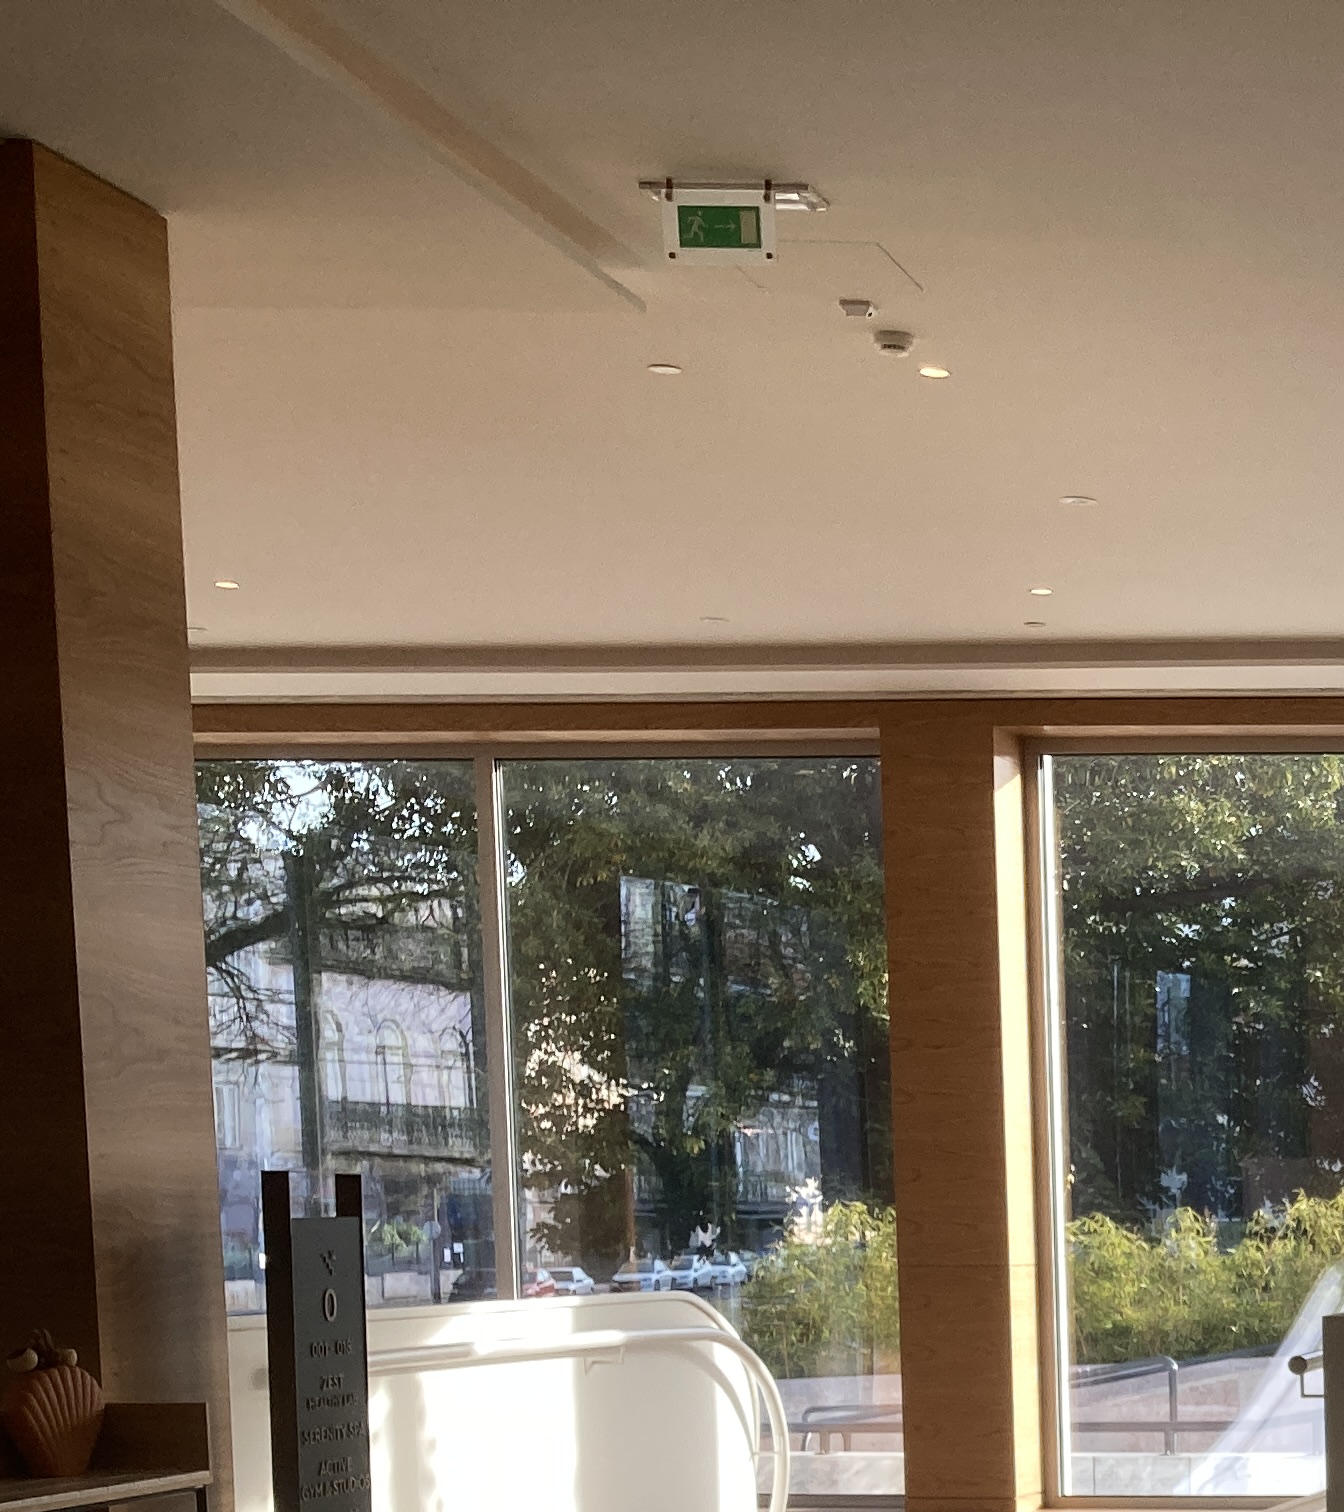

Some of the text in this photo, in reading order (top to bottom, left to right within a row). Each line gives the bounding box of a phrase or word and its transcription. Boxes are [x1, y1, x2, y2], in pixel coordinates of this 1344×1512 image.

[320, 1373, 344, 1391] ZEST
[302, 1424, 347, 1446] SERENITY
[319, 1456, 352, 1477] ACTIVE
[301, 1483, 325, 1501] GYM
[333, 1474, 370, 1496] STUDIOS
